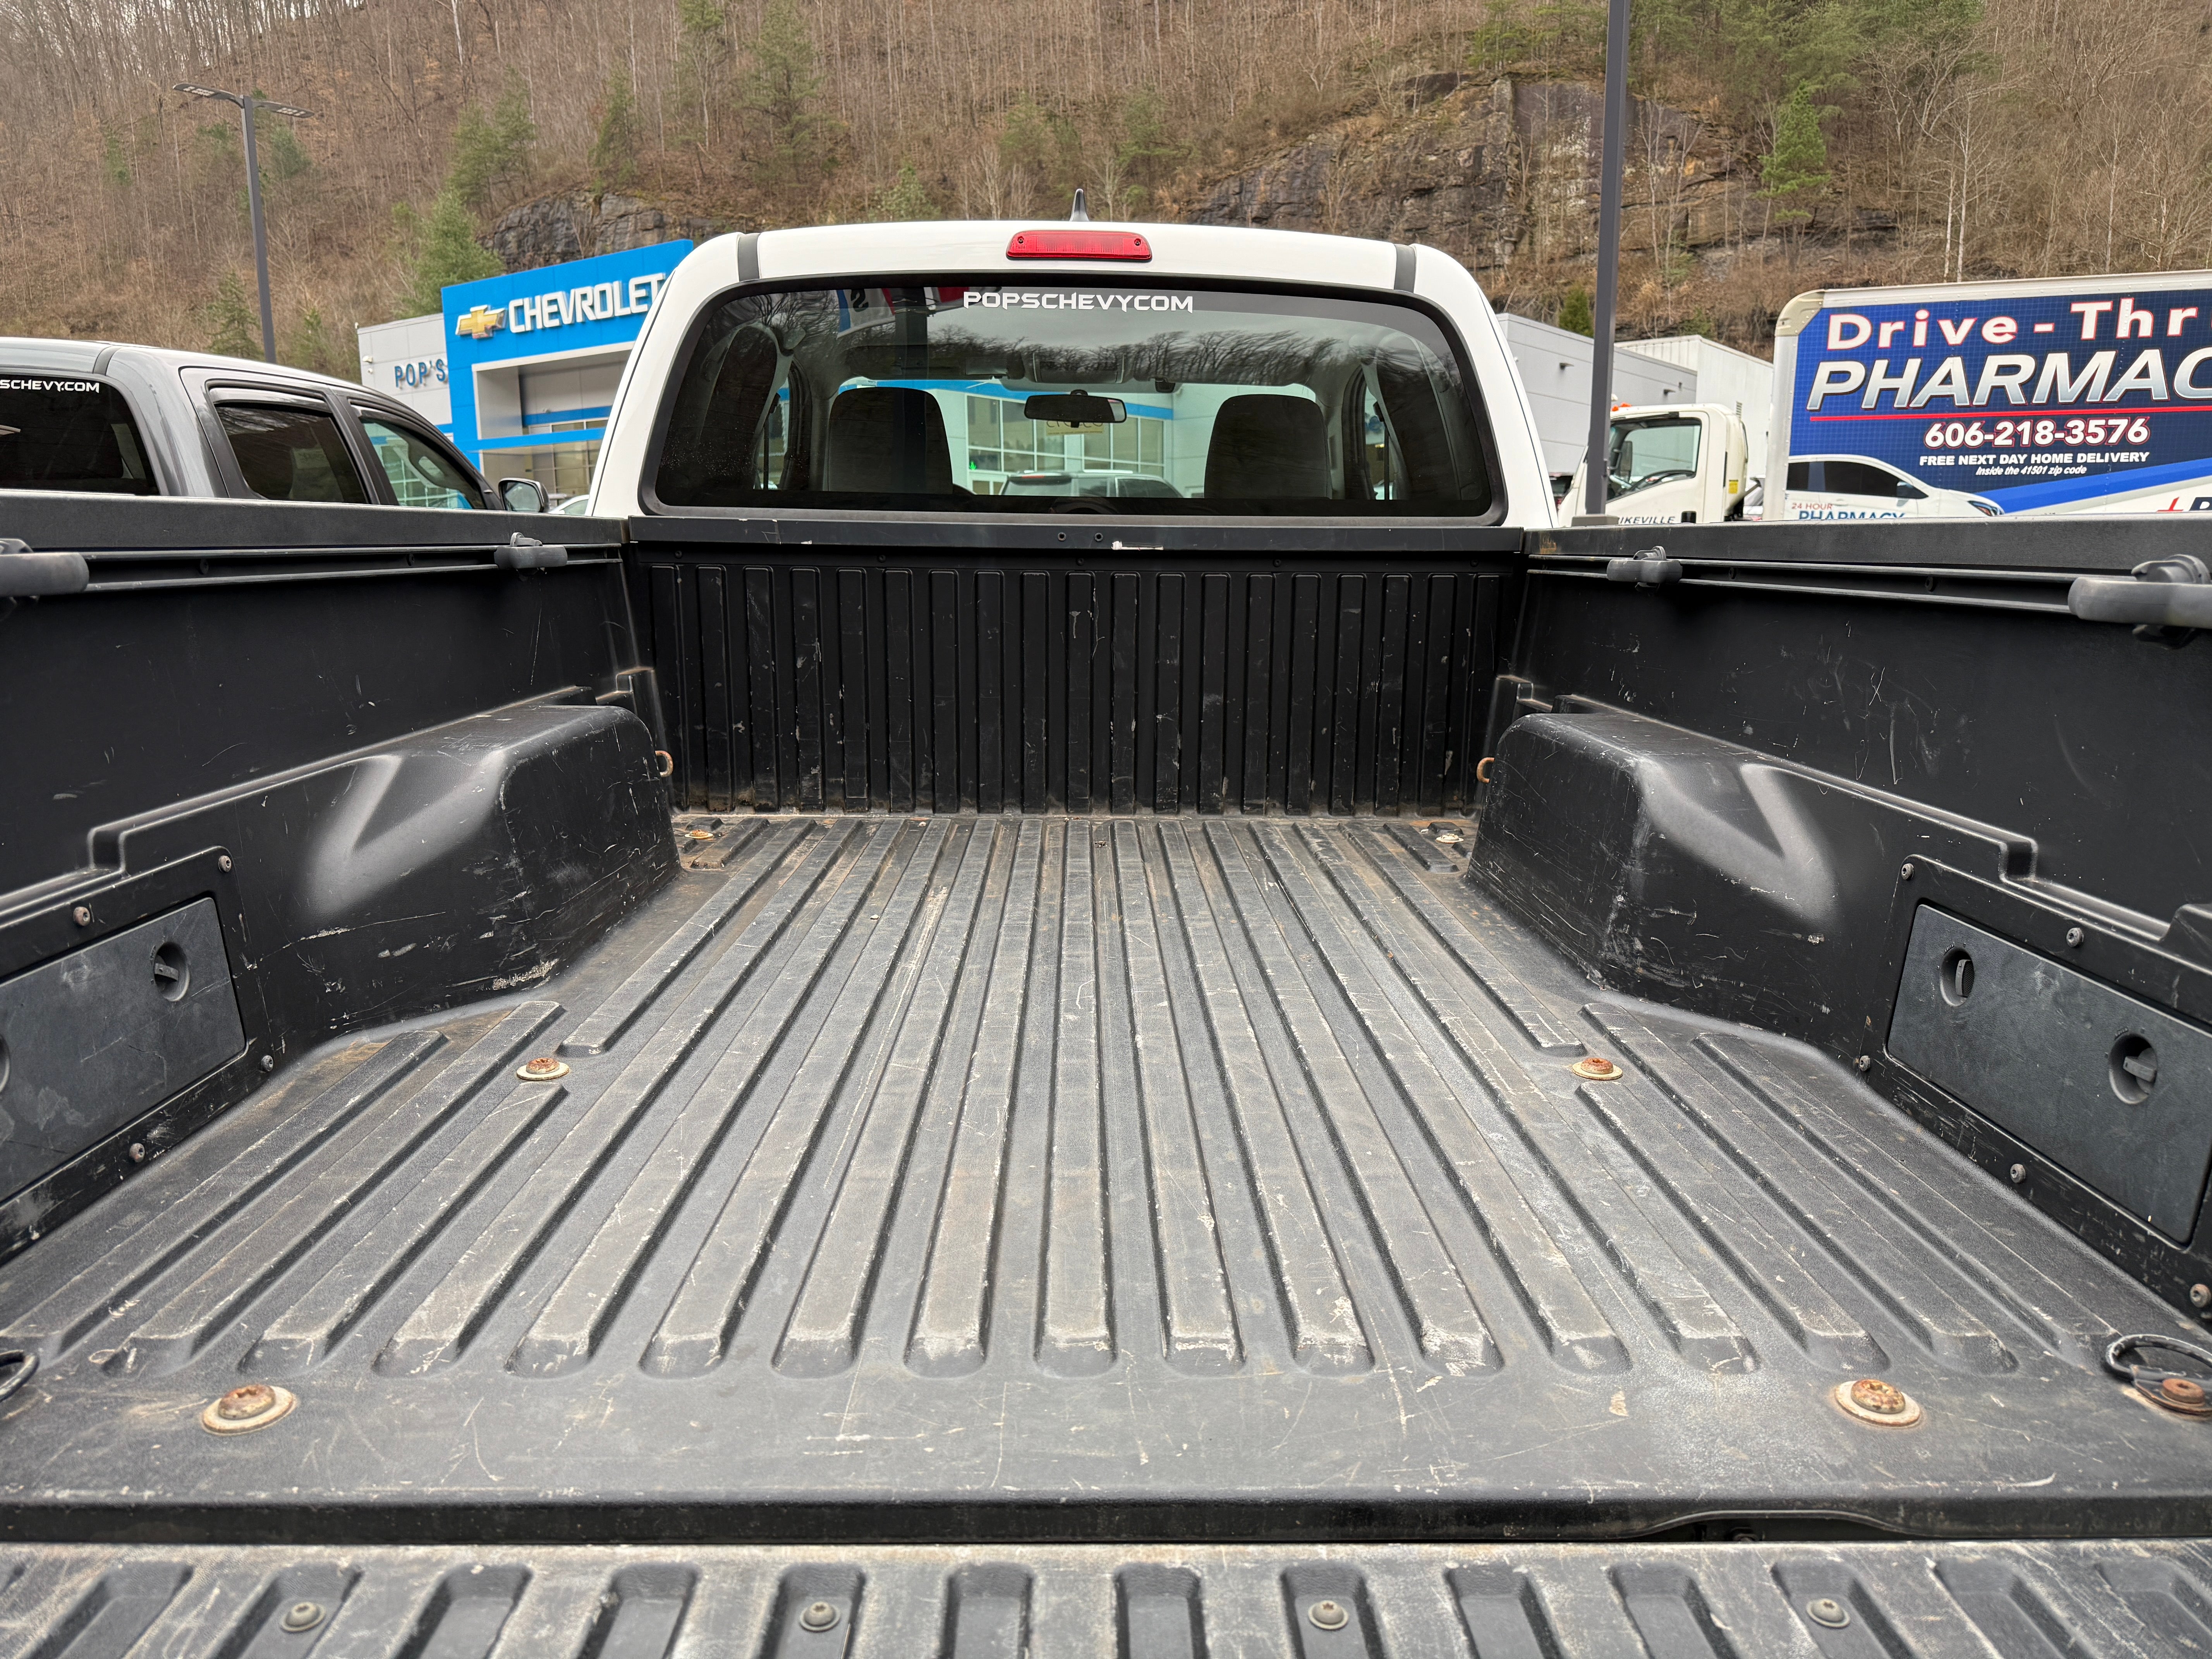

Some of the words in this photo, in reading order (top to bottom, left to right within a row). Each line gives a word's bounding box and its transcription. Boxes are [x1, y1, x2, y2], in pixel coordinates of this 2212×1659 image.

[508, 273, 665, 333] CHEVROLET
[394, 359, 446, 388] POP'S
[1924, 416, 2150, 449] 606-218-3576
[1919, 455, 1955, 465] FREE
[1958, 455, 1996, 465] NEXT
[1999, 454, 2028, 464] DAY
[2031, 453, 2073, 464] HOME
[2077, 452, 2150, 463] DELIVERY
[1975, 466, 2004, 476] Inside
[2004, 466, 2020, 475] the
[2020, 465, 2048, 475] 41501
[2048, 465, 2063, 476] zip
[2064, 465, 2087, 474] code
